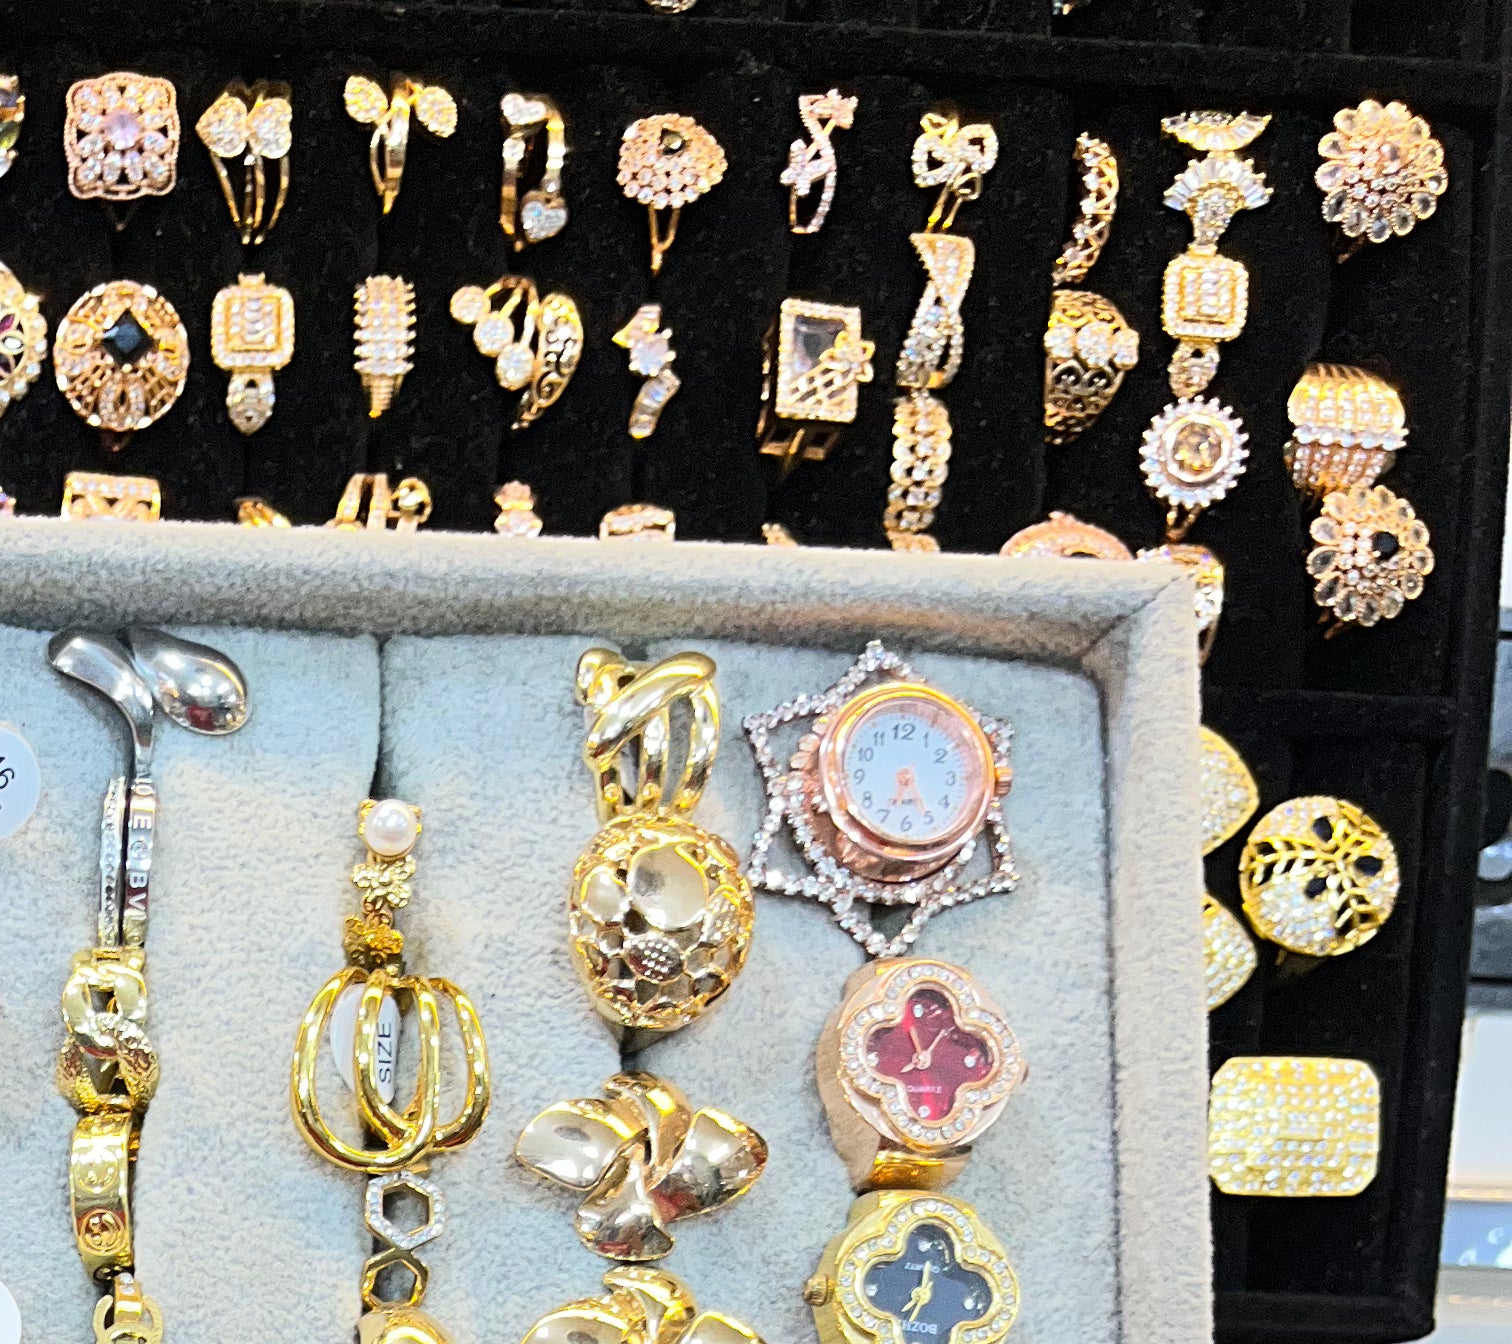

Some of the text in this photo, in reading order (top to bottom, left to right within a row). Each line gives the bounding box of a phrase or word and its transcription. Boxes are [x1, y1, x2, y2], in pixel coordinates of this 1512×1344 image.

[873, 731, 886, 747] 11
[893, 722, 916, 741] 12
[923, 731, 930, 748] 1
[857, 746, 874, 762] 10
[934, 748, 948, 764] 2
[853, 768, 865, 785] 9
[945, 770, 956, 786] 3
[861, 790, 874, 809] 8
[938, 794, 950, 809] 4
[877, 808, 892, 824] 7
[900, 815, 913, 832] 6
[924, 810, 934, 825] 5
[377, 1022, 392, 1084] SIZE
